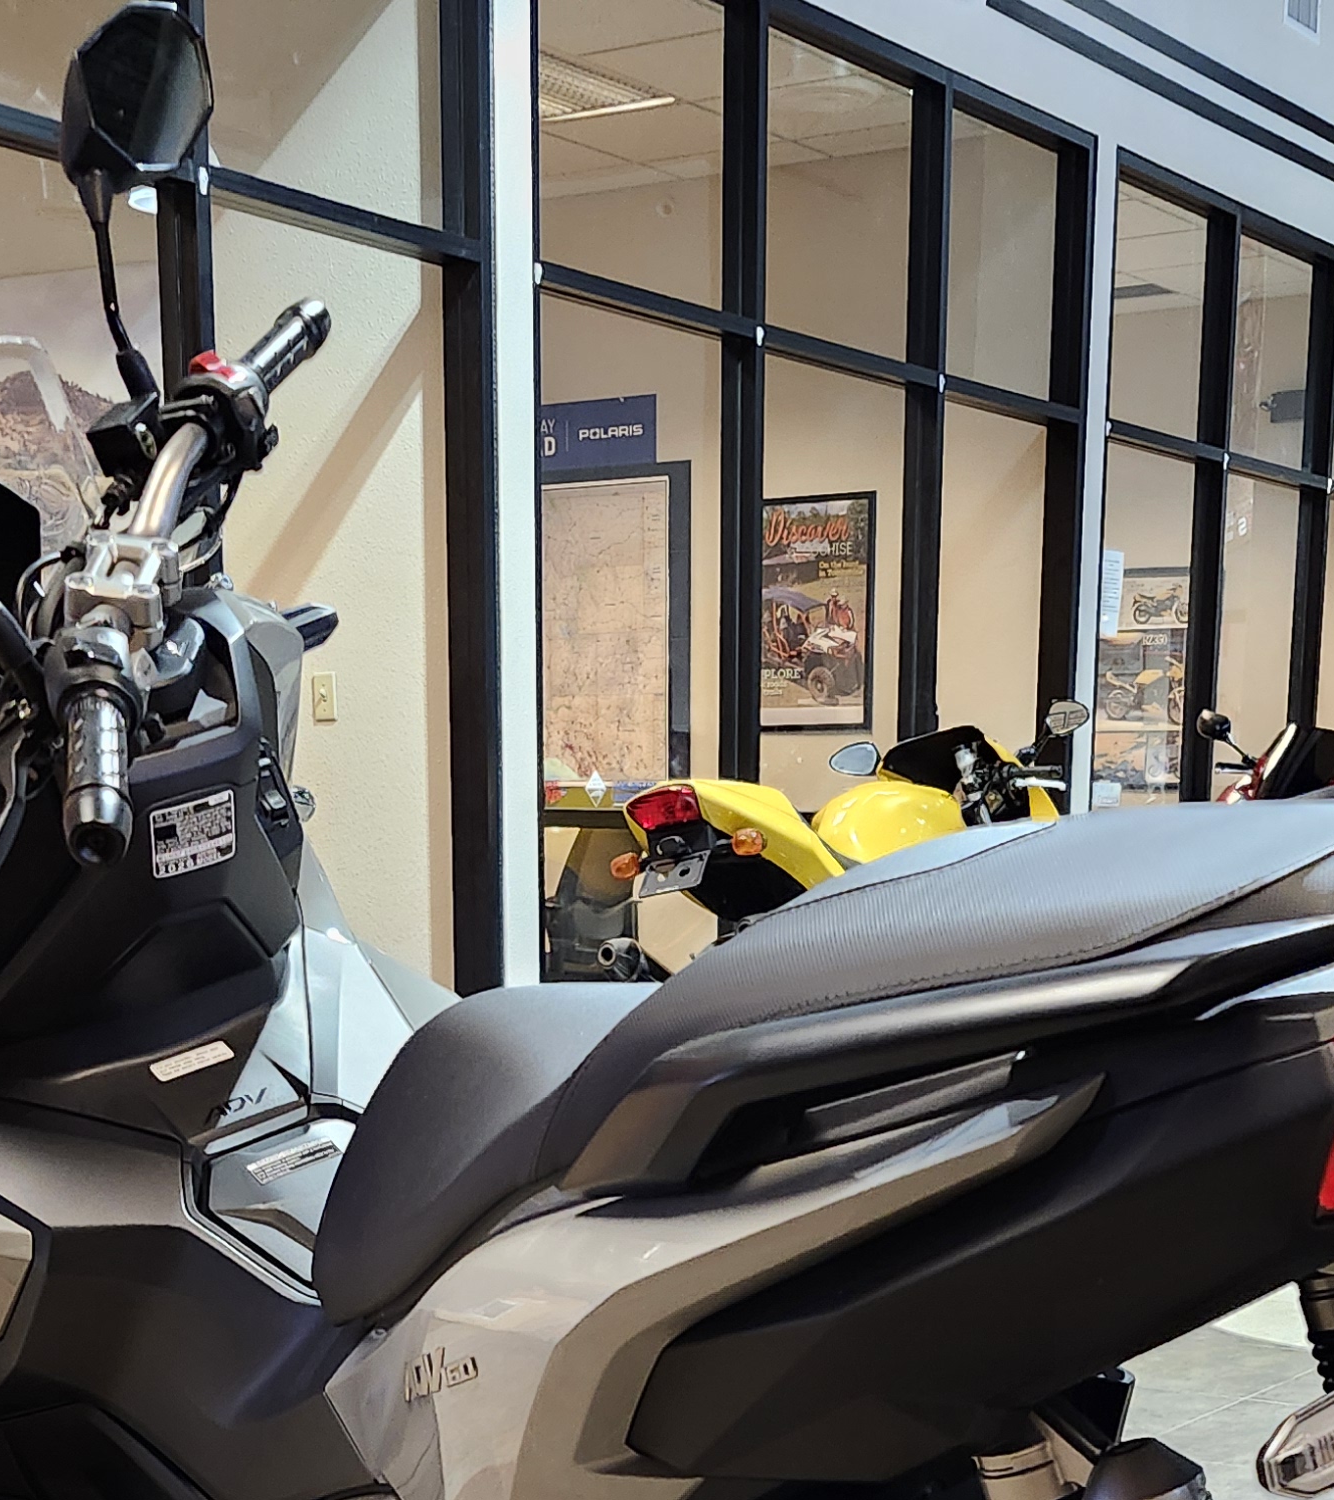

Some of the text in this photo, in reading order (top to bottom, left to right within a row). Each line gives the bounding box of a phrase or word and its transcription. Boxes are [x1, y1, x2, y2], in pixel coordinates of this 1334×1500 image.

[540, 418, 556, 434] AY
[578, 423, 644, 441] POLARIS
[540, 436, 556, 457] D
[765, 508, 850, 547] Discover
[762, 668, 802, 680] PLORE
